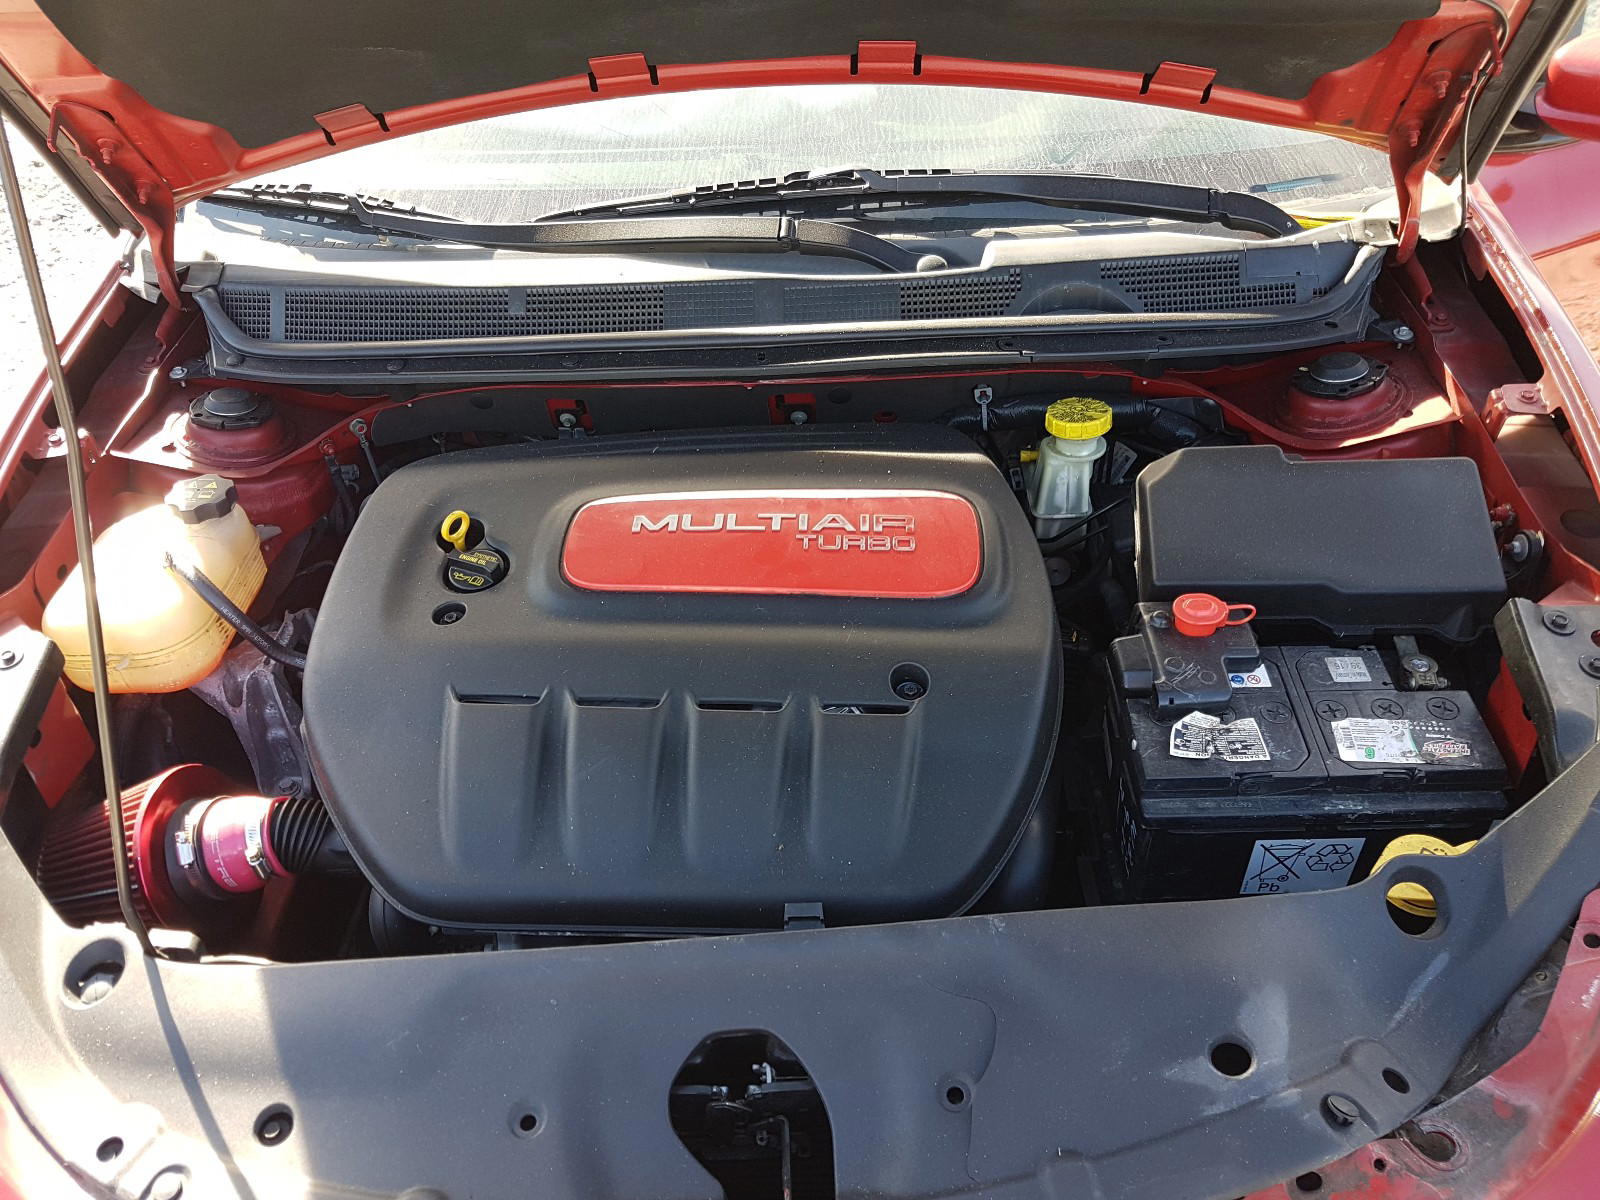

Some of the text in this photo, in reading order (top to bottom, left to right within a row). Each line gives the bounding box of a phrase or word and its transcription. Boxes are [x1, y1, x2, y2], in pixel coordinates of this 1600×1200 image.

[632, 513, 915, 533] MULTIAIR
[796, 534, 916, 551] TURBO
[1257, 882, 1281, 892] Pb
